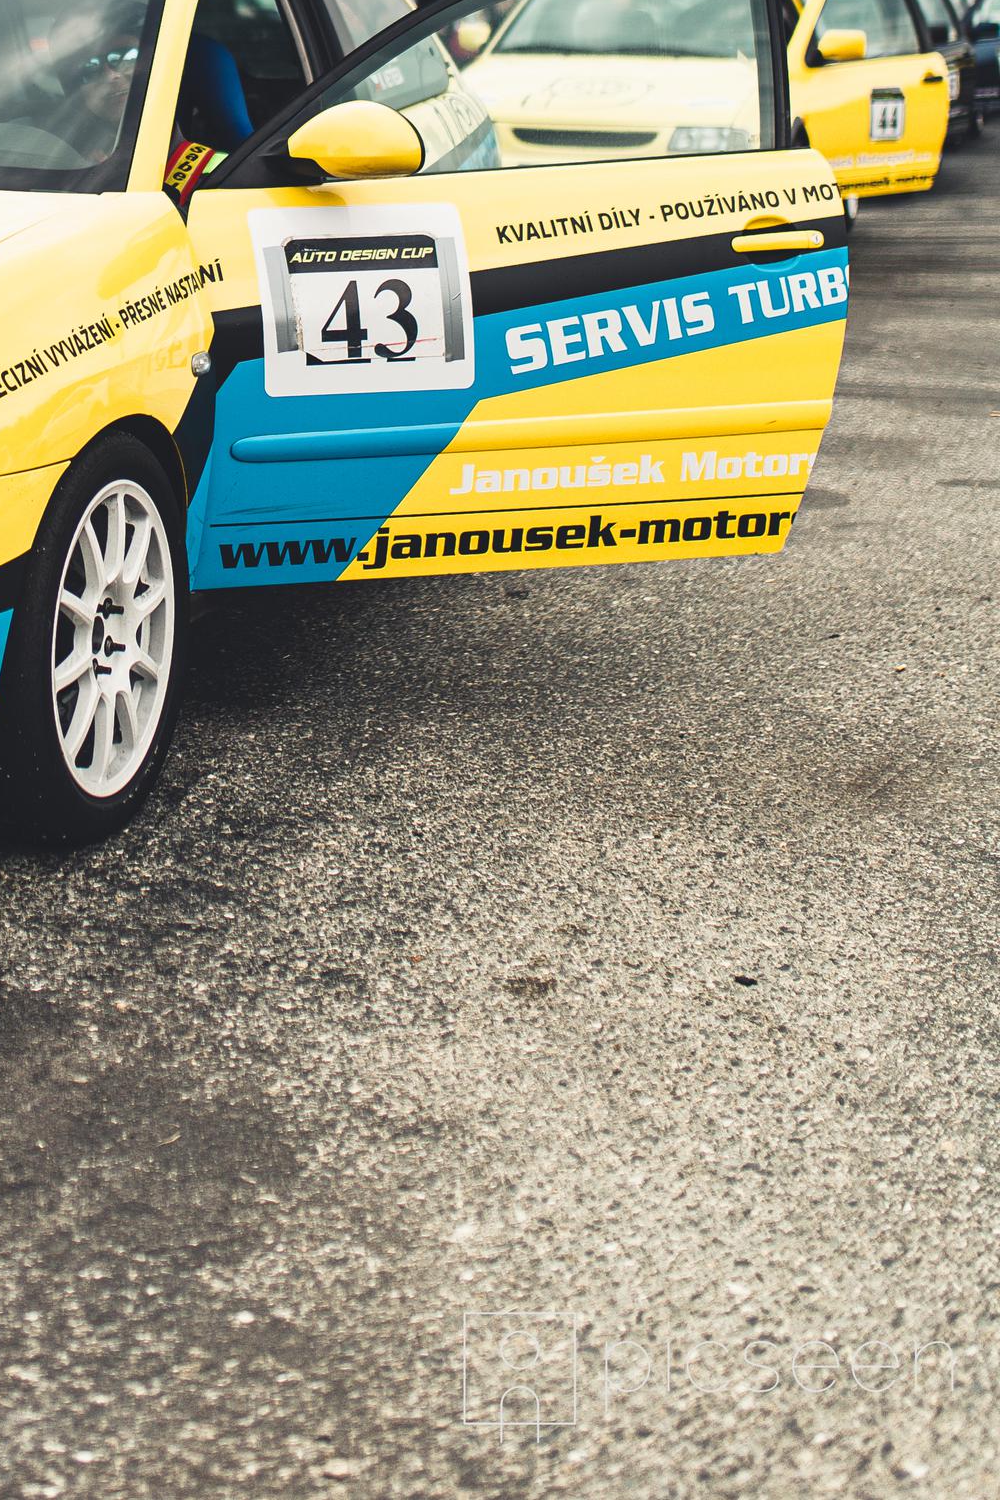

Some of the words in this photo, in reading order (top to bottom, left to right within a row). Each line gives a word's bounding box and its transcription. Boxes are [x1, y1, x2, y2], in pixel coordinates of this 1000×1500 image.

[879, 106, 899, 130] 44
[495, 214, 594, 244] KVALITNÍ
[600, 207, 641, 231] DÍLY
[660, 190, 780, 222] POUŽÍVÁNO
[783, 188, 797, 206] V
[289, 251, 336, 264] AUTO
[340, 248, 399, 262] DESIGN
[401, 246, 434, 259] CUP
[43, 312, 116, 368] VYVÁŽENÍ
[118, 285, 168, 330] PŘESNÉ
[320, 278, 419, 359] 43
[504, 290, 716, 376] SERVIS
[449, 455, 666, 496] Janoušek
[219, 509, 798, 570] www.janousek-motor
